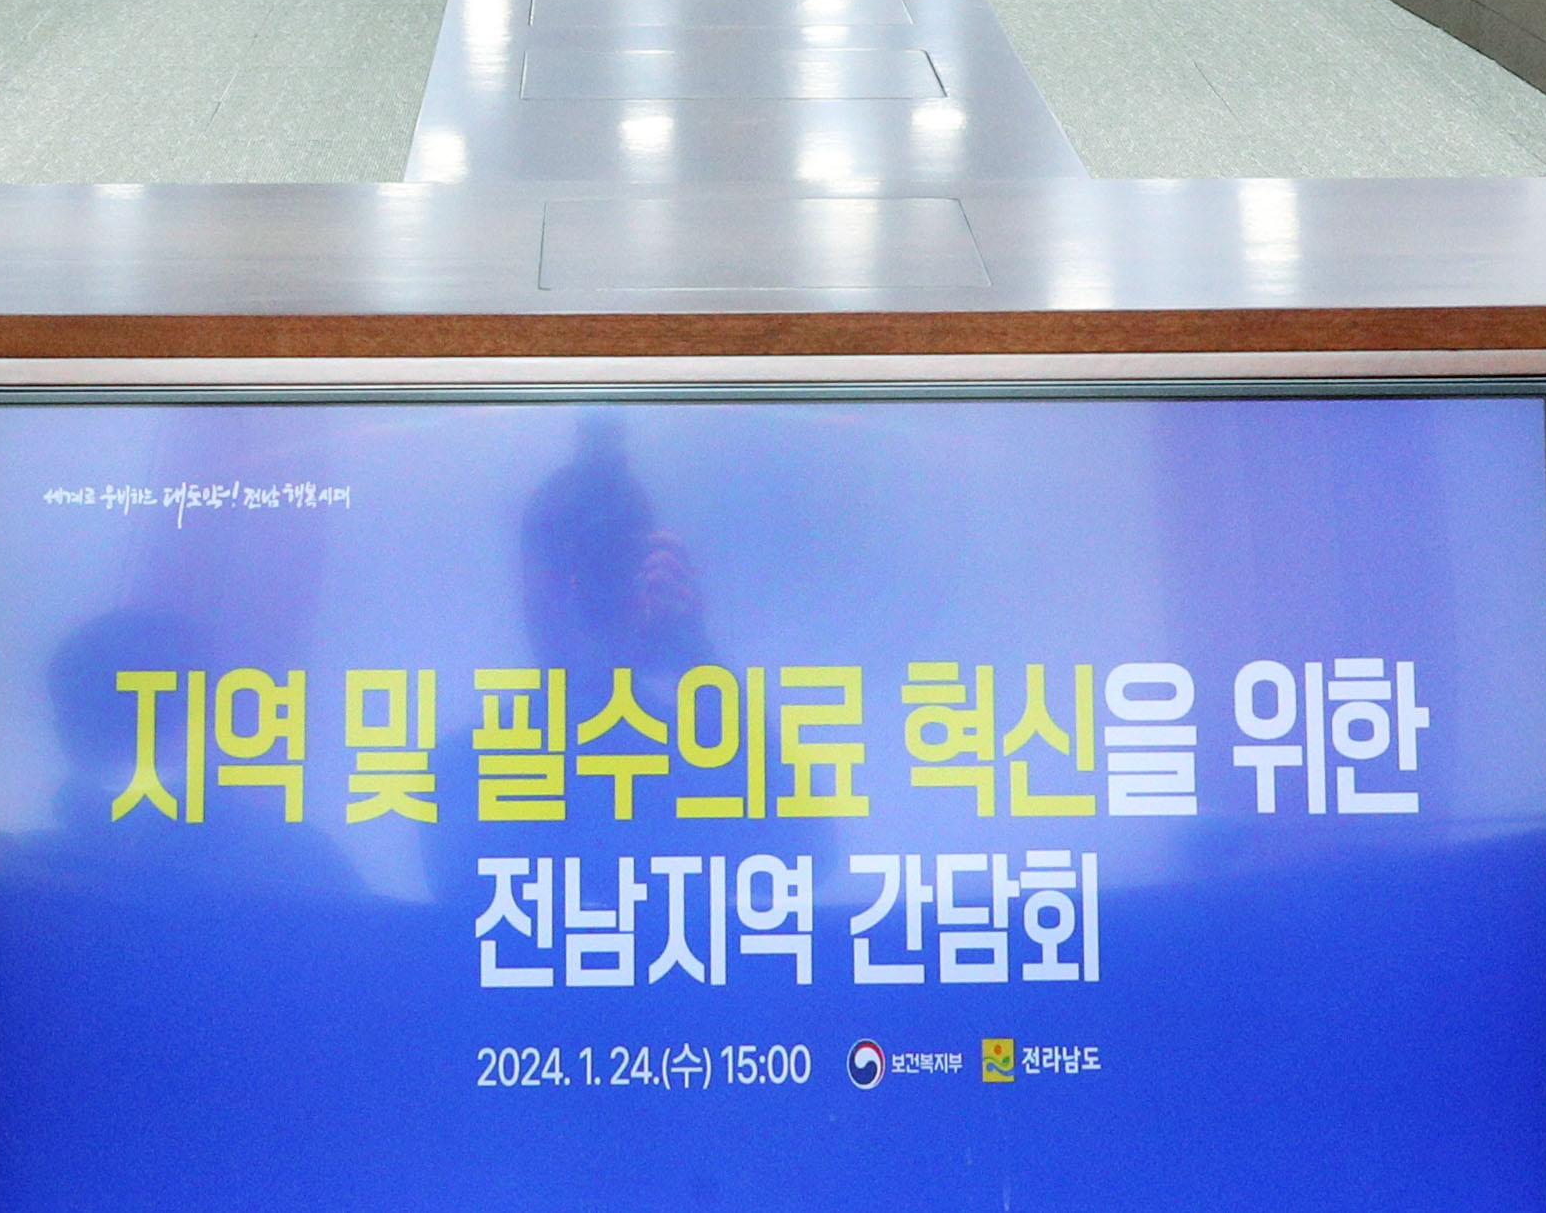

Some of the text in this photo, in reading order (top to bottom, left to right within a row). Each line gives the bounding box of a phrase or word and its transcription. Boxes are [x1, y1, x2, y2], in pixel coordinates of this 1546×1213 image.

[42, 484, 97, 506] 세계로
[243, 486, 281, 510] 전남
[111, 656, 1431, 824] 지역 및 필수의료 혁신을 위한
[474, 849, 1101, 988] 전남지역 간담회
[477, 1042, 1102, 1090] 2024. 1. 24.(수) 15:00 보건복지부 전라남도
